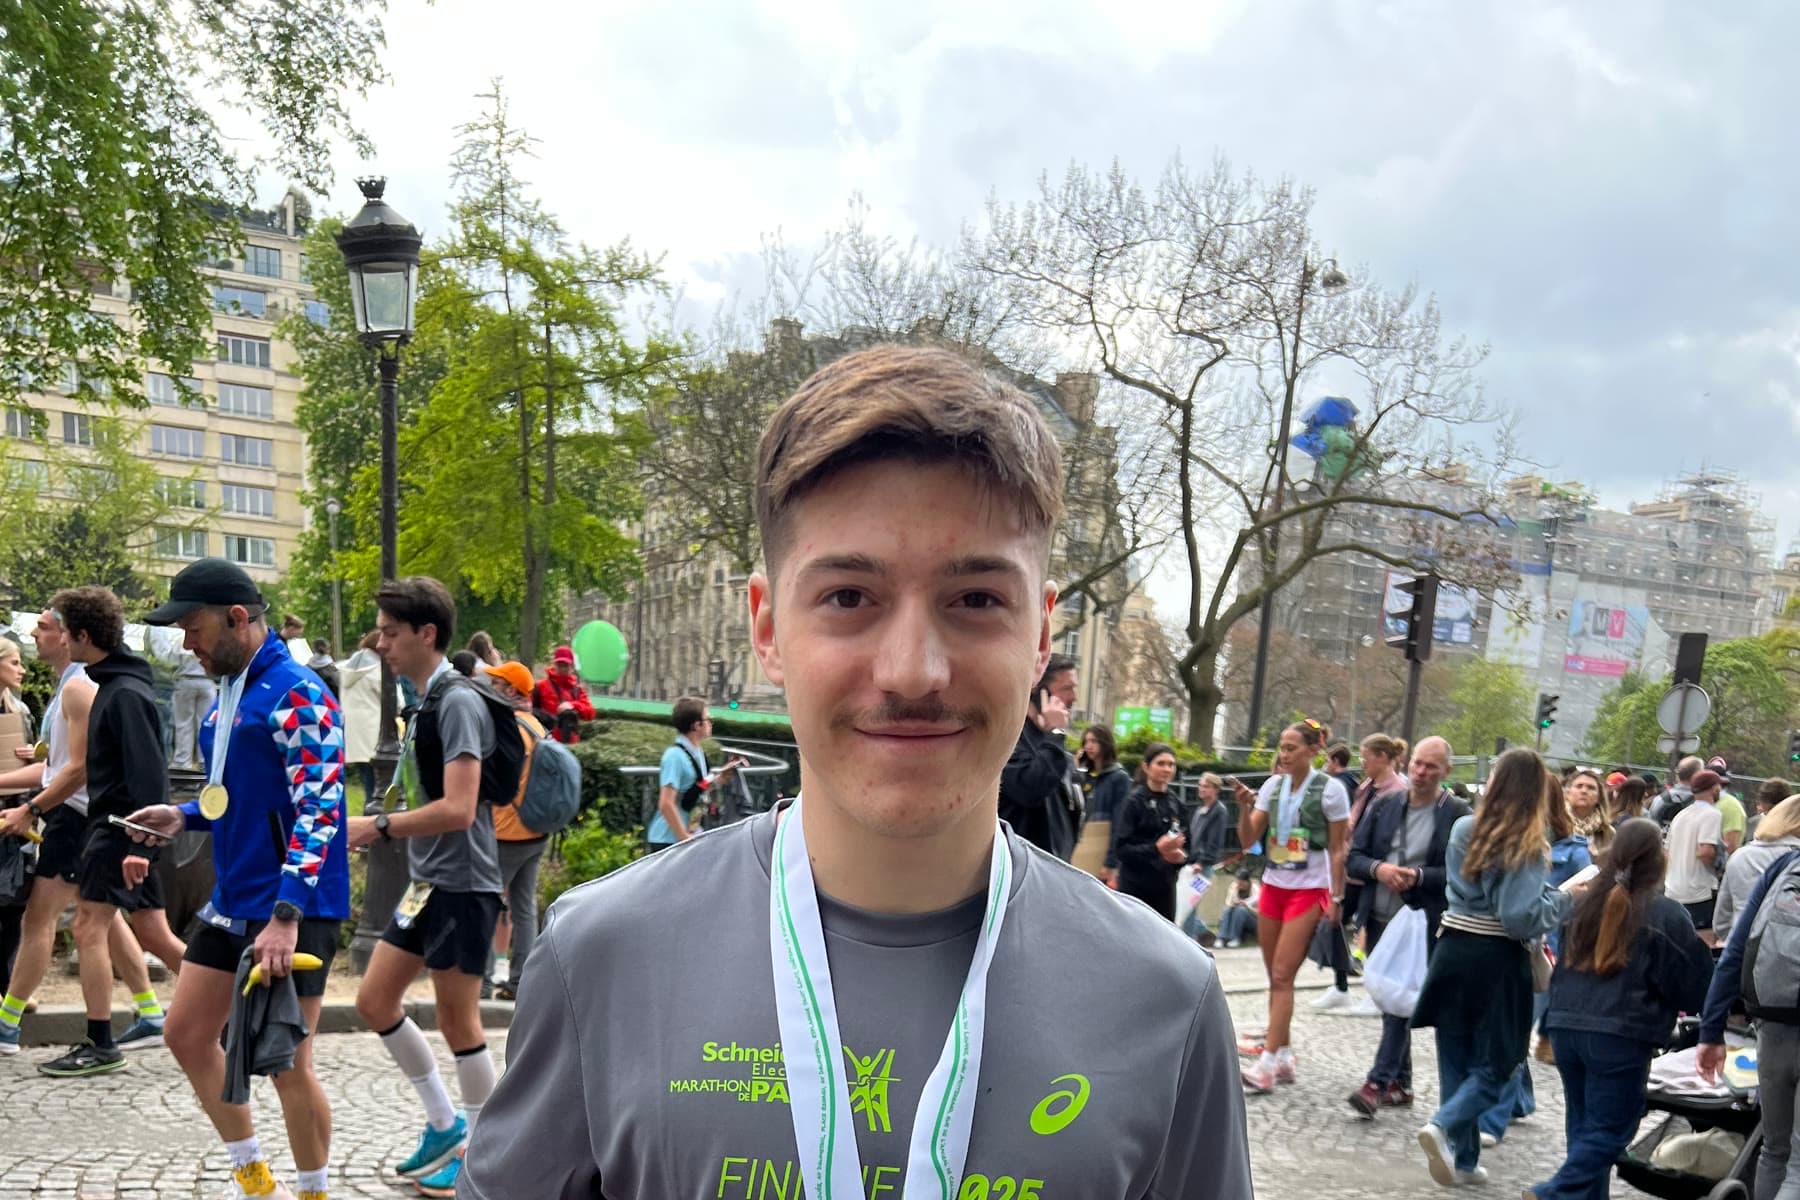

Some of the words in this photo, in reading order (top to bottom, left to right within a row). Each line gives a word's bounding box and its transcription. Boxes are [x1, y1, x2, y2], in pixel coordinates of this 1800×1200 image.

[752, 1063, 786, 1076] Elec
[670, 1079, 751, 1093] MARATHON
[738, 1092, 751, 1102] DE
[751, 1081, 790, 1103] PA
